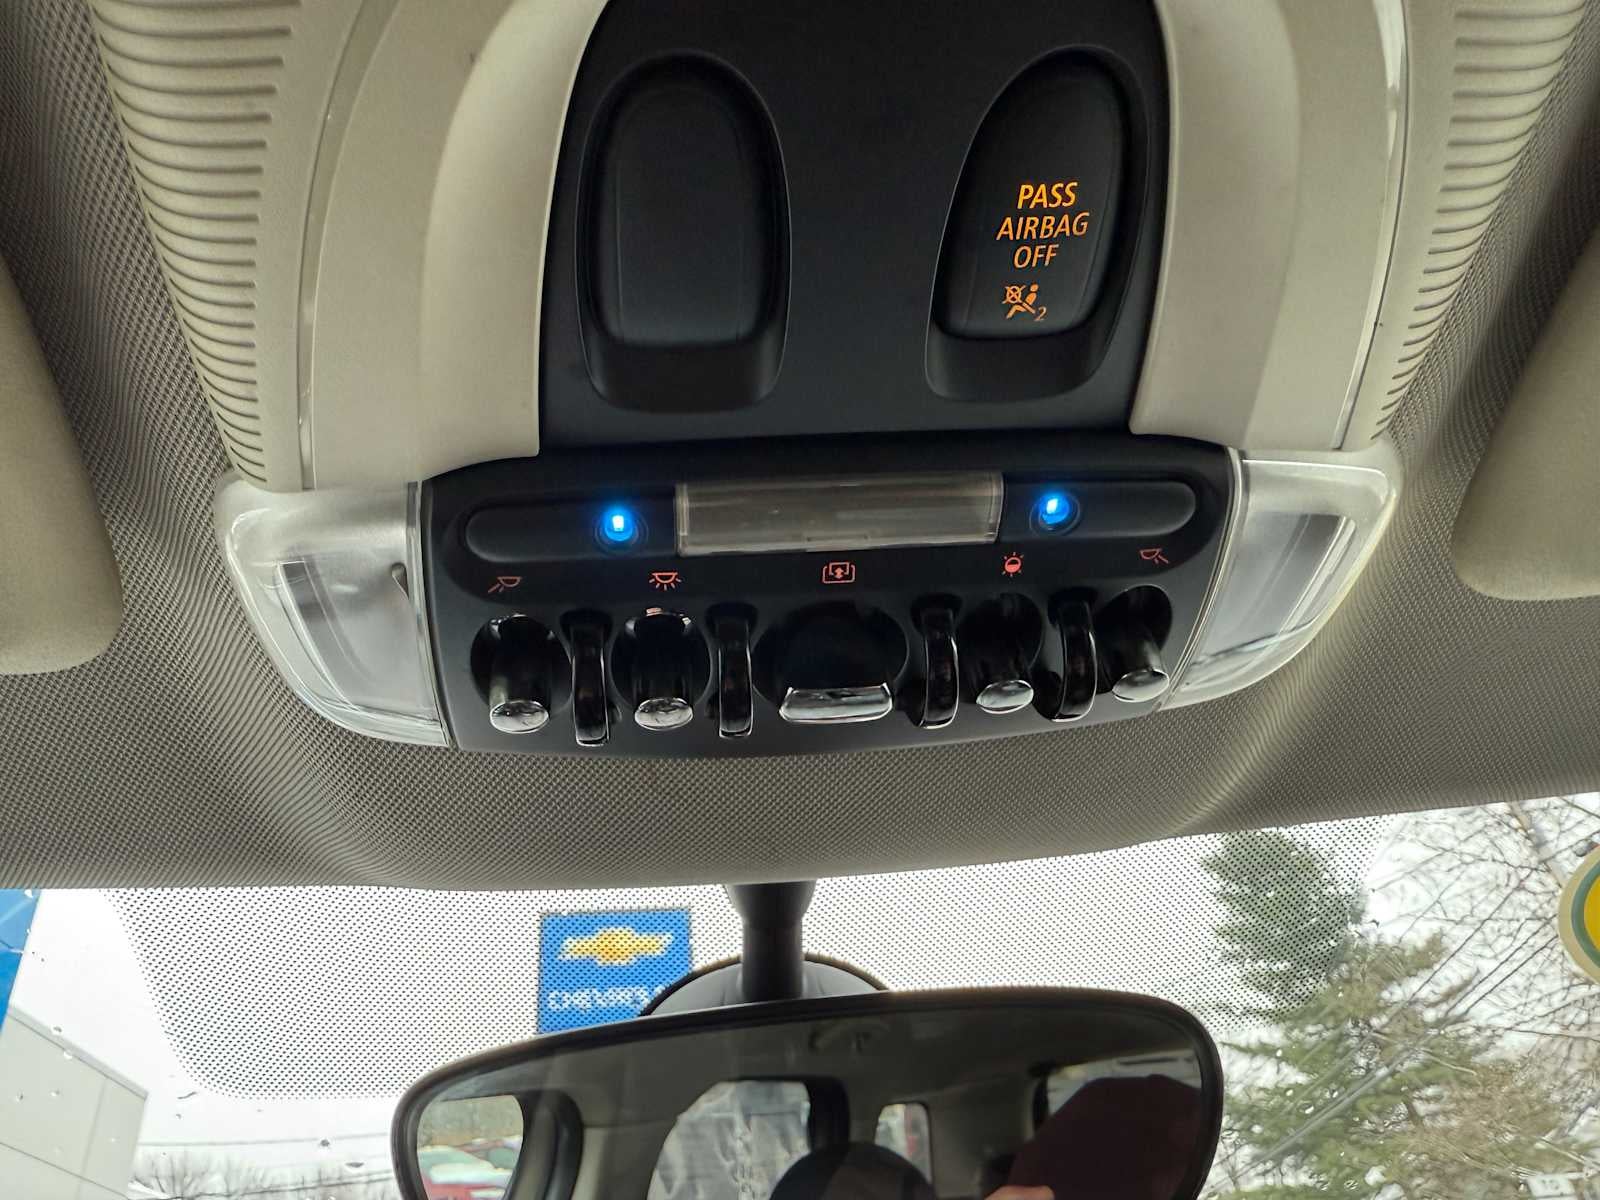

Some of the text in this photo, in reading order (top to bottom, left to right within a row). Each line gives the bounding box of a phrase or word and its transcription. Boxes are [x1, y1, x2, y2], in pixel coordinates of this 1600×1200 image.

[1017, 182, 1078, 209] PASS
[996, 212, 1090, 241] AIRBAG
[1013, 244, 1059, 269] OFF
[1034, 306, 1048, 322] 2
